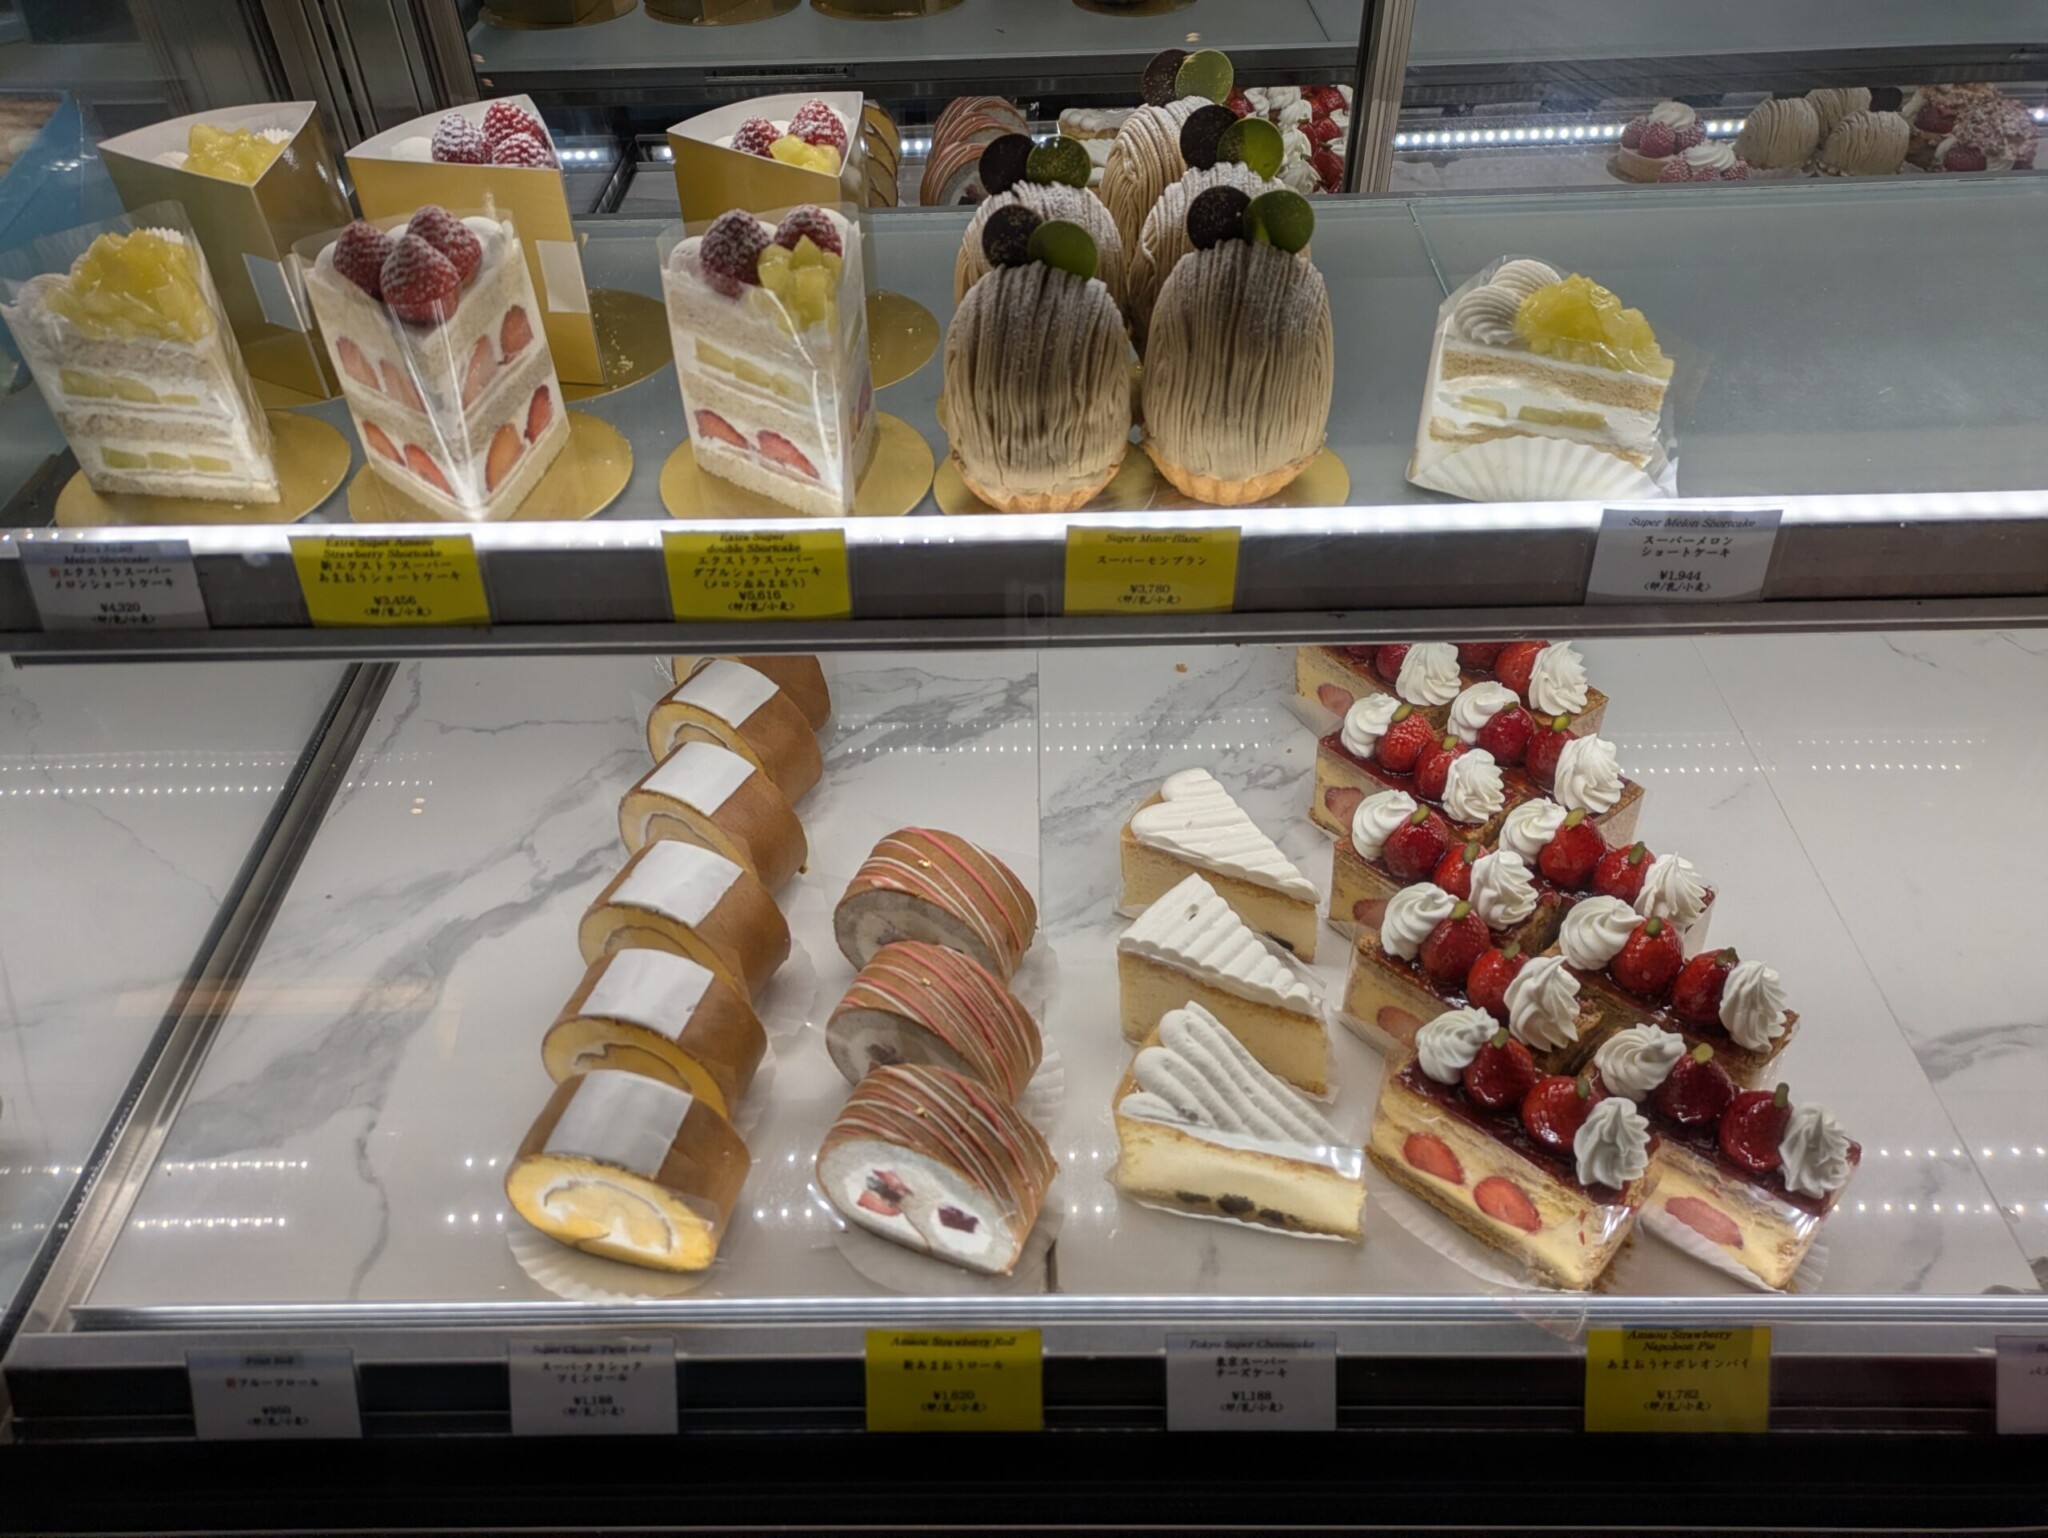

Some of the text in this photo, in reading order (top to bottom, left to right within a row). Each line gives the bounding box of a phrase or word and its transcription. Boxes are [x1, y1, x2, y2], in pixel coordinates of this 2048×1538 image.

[1629, 517, 1756, 528] Super Melon Shortcake
[1105, 534, 1136, 545] Super
[1644, 536, 1733, 545] スーパーメロン
[324, 549, 384, 560] Strawberry
[1641, 547, 1730, 558] ショートケーキ
[698, 555, 815, 565] エクストラスーパー
[1097, 556, 1208, 566] スーパーモンブラン
[1660, 571, 1702, 581] ¥1,944
[1670, 1330, 1733, 1340] Strawberry
[1224, 1340, 1253, 1350] Super
[1697, 1341, 1716, 1351] Pie
[1216, 1367, 1289, 1378] チーズケーキ
